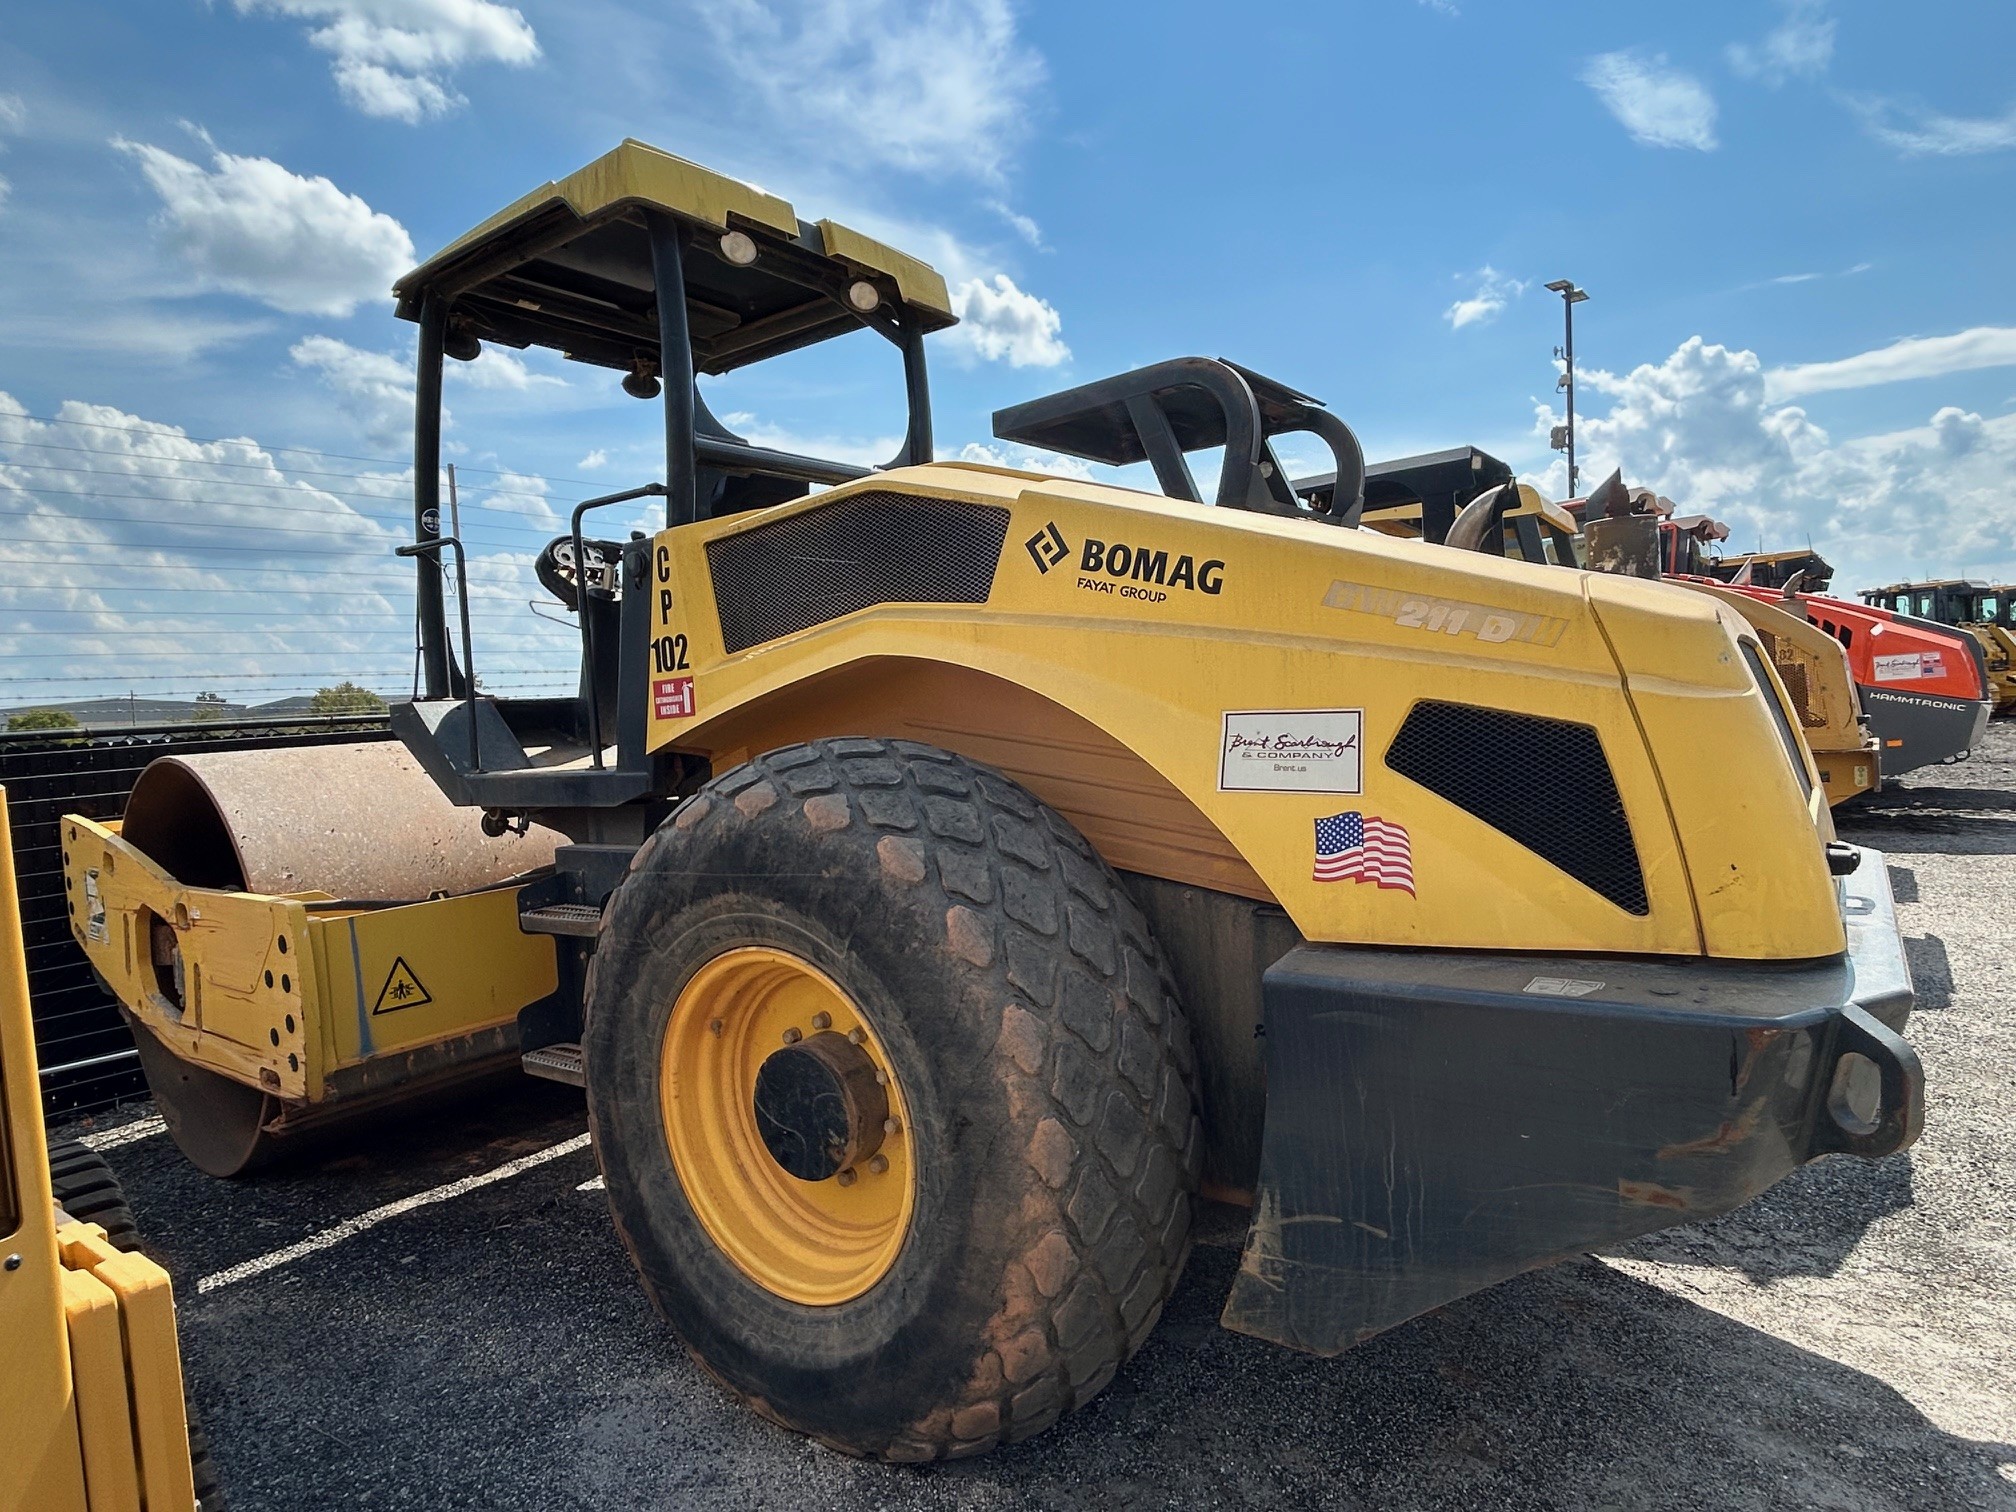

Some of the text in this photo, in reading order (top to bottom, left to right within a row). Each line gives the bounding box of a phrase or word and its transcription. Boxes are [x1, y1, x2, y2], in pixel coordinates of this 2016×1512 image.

[1080, 538, 1226, 595] BOMAG
[1077, 577, 1168, 604] FAYAT GROUP
[1394, 600, 1516, 643] 211 D
[651, 633, 690, 673] 102
[1869, 692, 1967, 712] HAMMTRONIC
[1229, 732, 1270, 753] Brent
[1257, 751, 1334, 759] COMPANY
